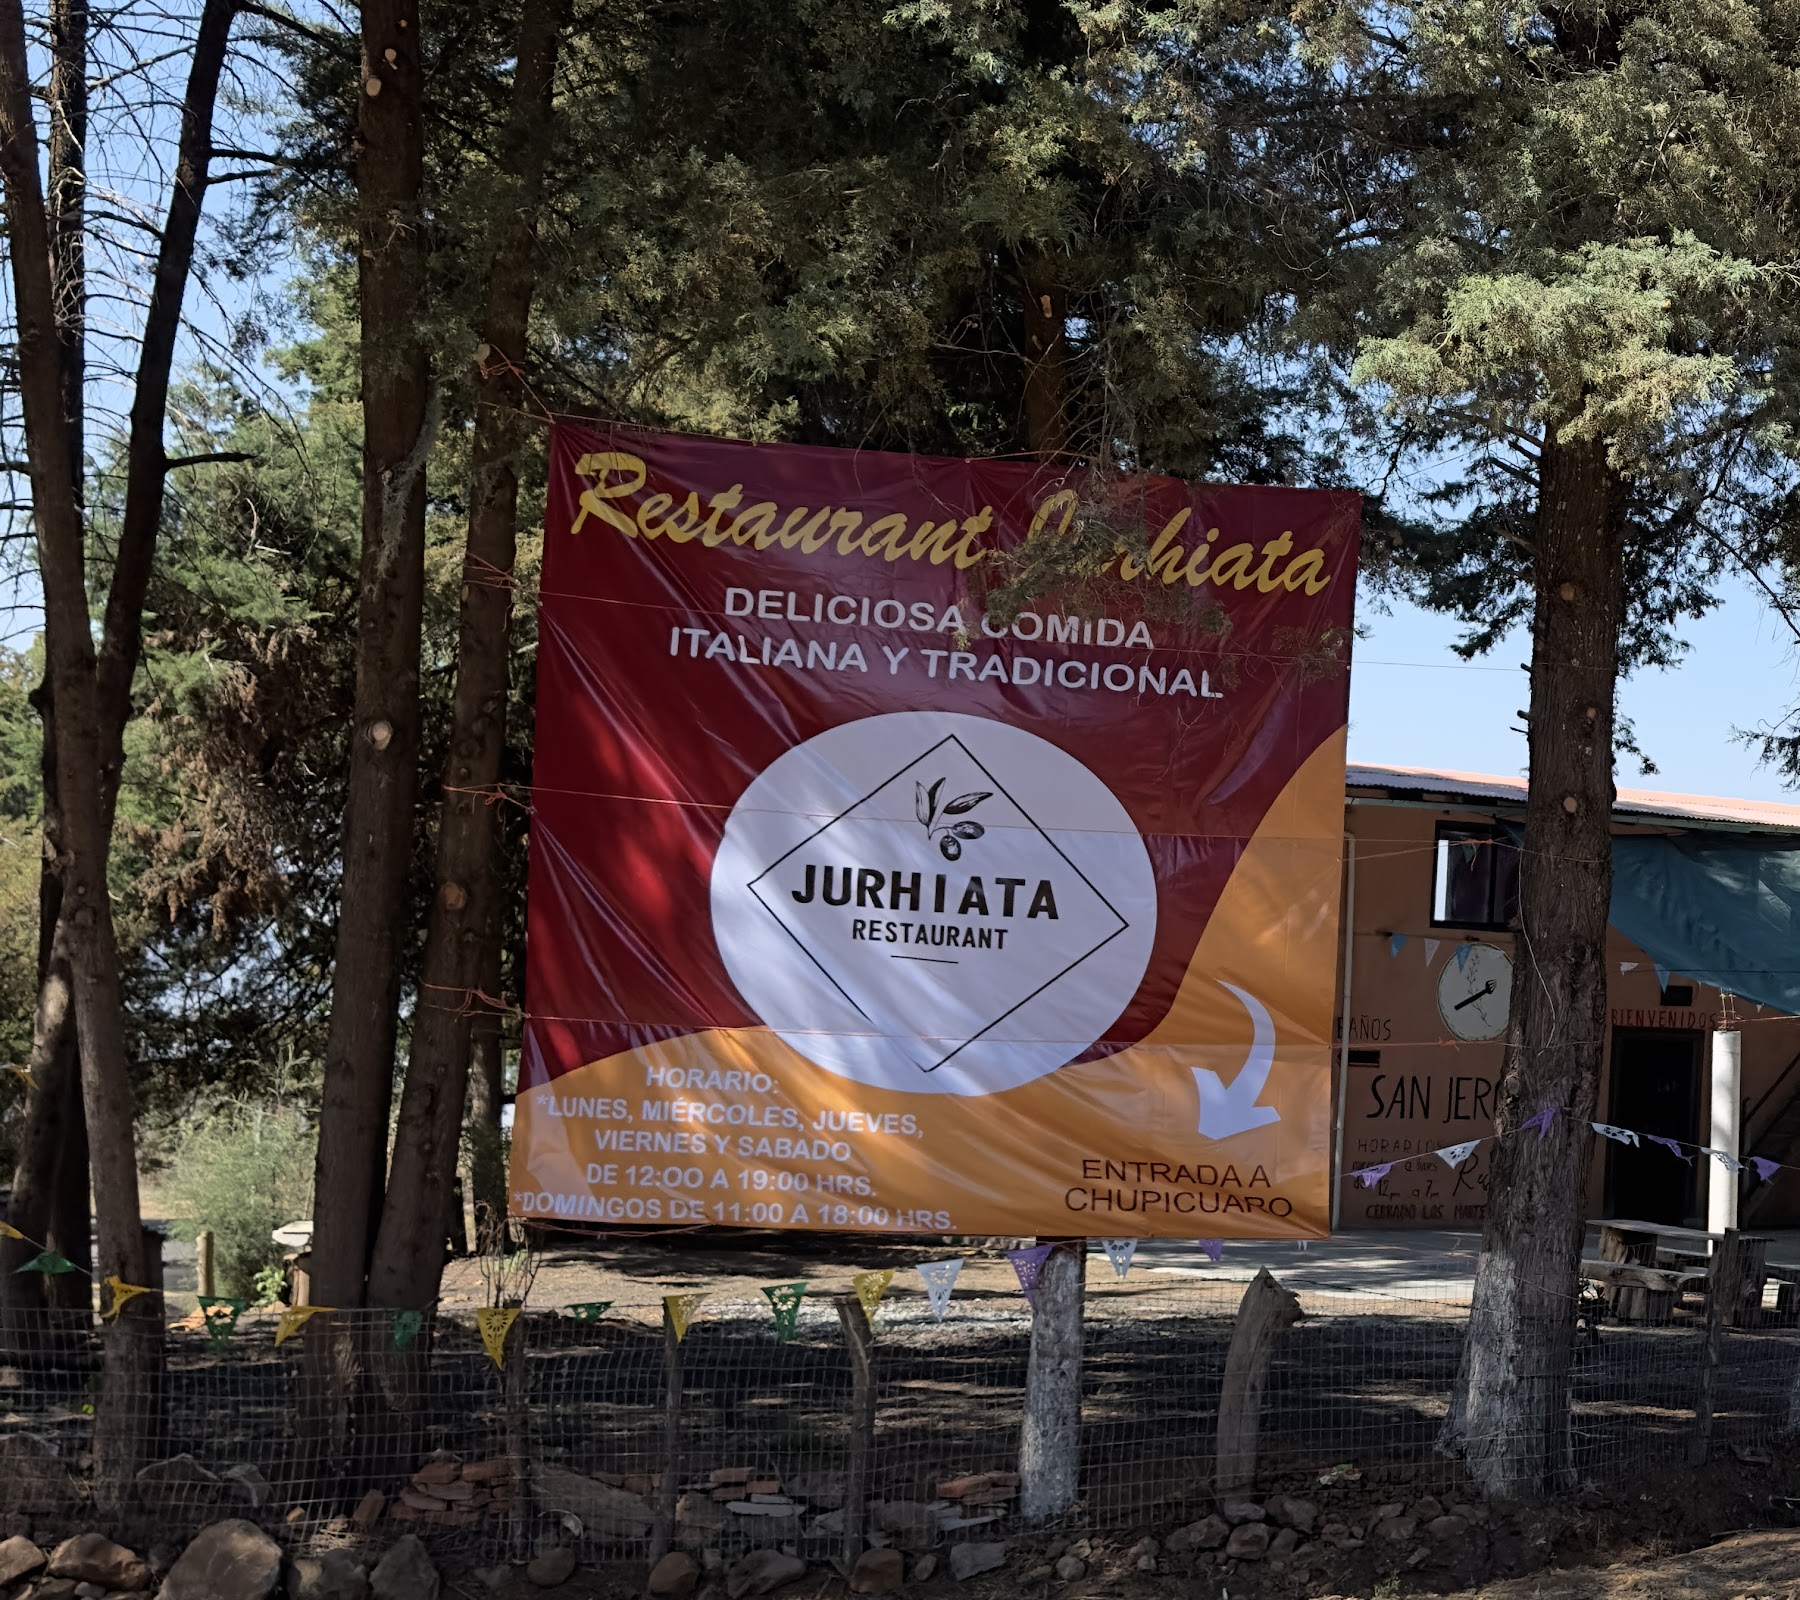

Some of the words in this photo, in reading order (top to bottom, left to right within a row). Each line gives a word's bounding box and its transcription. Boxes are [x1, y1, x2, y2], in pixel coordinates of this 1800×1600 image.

[571, 452, 993, 569] Restaurant
[725, 586, 964, 633] DELICIOSA
[981, 611, 1155, 649] COMIDA
[669, 626, 868, 673] ITALIANA
[882, 645, 909, 675] Y
[920, 648, 1224, 699] TRADICIONAL
[791, 864, 1060, 920] JURHIATA
[852, 918, 1008, 950] RESTAURANT
[1611, 1008, 1717, 1030] BIENVENIDOS
[645, 1066, 780, 1095] HORARIO:
[1366, 1074, 1431, 1120] SAN
[1442, 1076, 1501, 1124] JER
[641, 1097, 805, 1131] MIÉRCOLES,
[811, 1110, 924, 1139] JUEVES,
[594, 1128, 707, 1155] VIERNES
[714, 1135, 731, 1154] Y
[737, 1135, 851, 1162] SABADO
[586, 1163, 619, 1185] DE
[710, 1168, 730, 1189] A
[737, 1169, 810, 1192] 19:00
[816, 1174, 878, 1197] HRS.
[1082, 1159, 1243, 1188] ENTRADA
[1249, 1164, 1272, 1188] A
[669, 1199, 707, 1219] DE
[713, 1201, 783, 1224] 11:00
[790, 1203, 809, 1224] A
[818, 1204, 890, 1227] 18:00
[896, 1209, 958, 1231] HRS.
[1065, 1187, 1293, 1218] CHUPICUARO
[1422, 1204, 1444, 1220] LOS
[1454, 1204, 1488, 1221] MARTE
